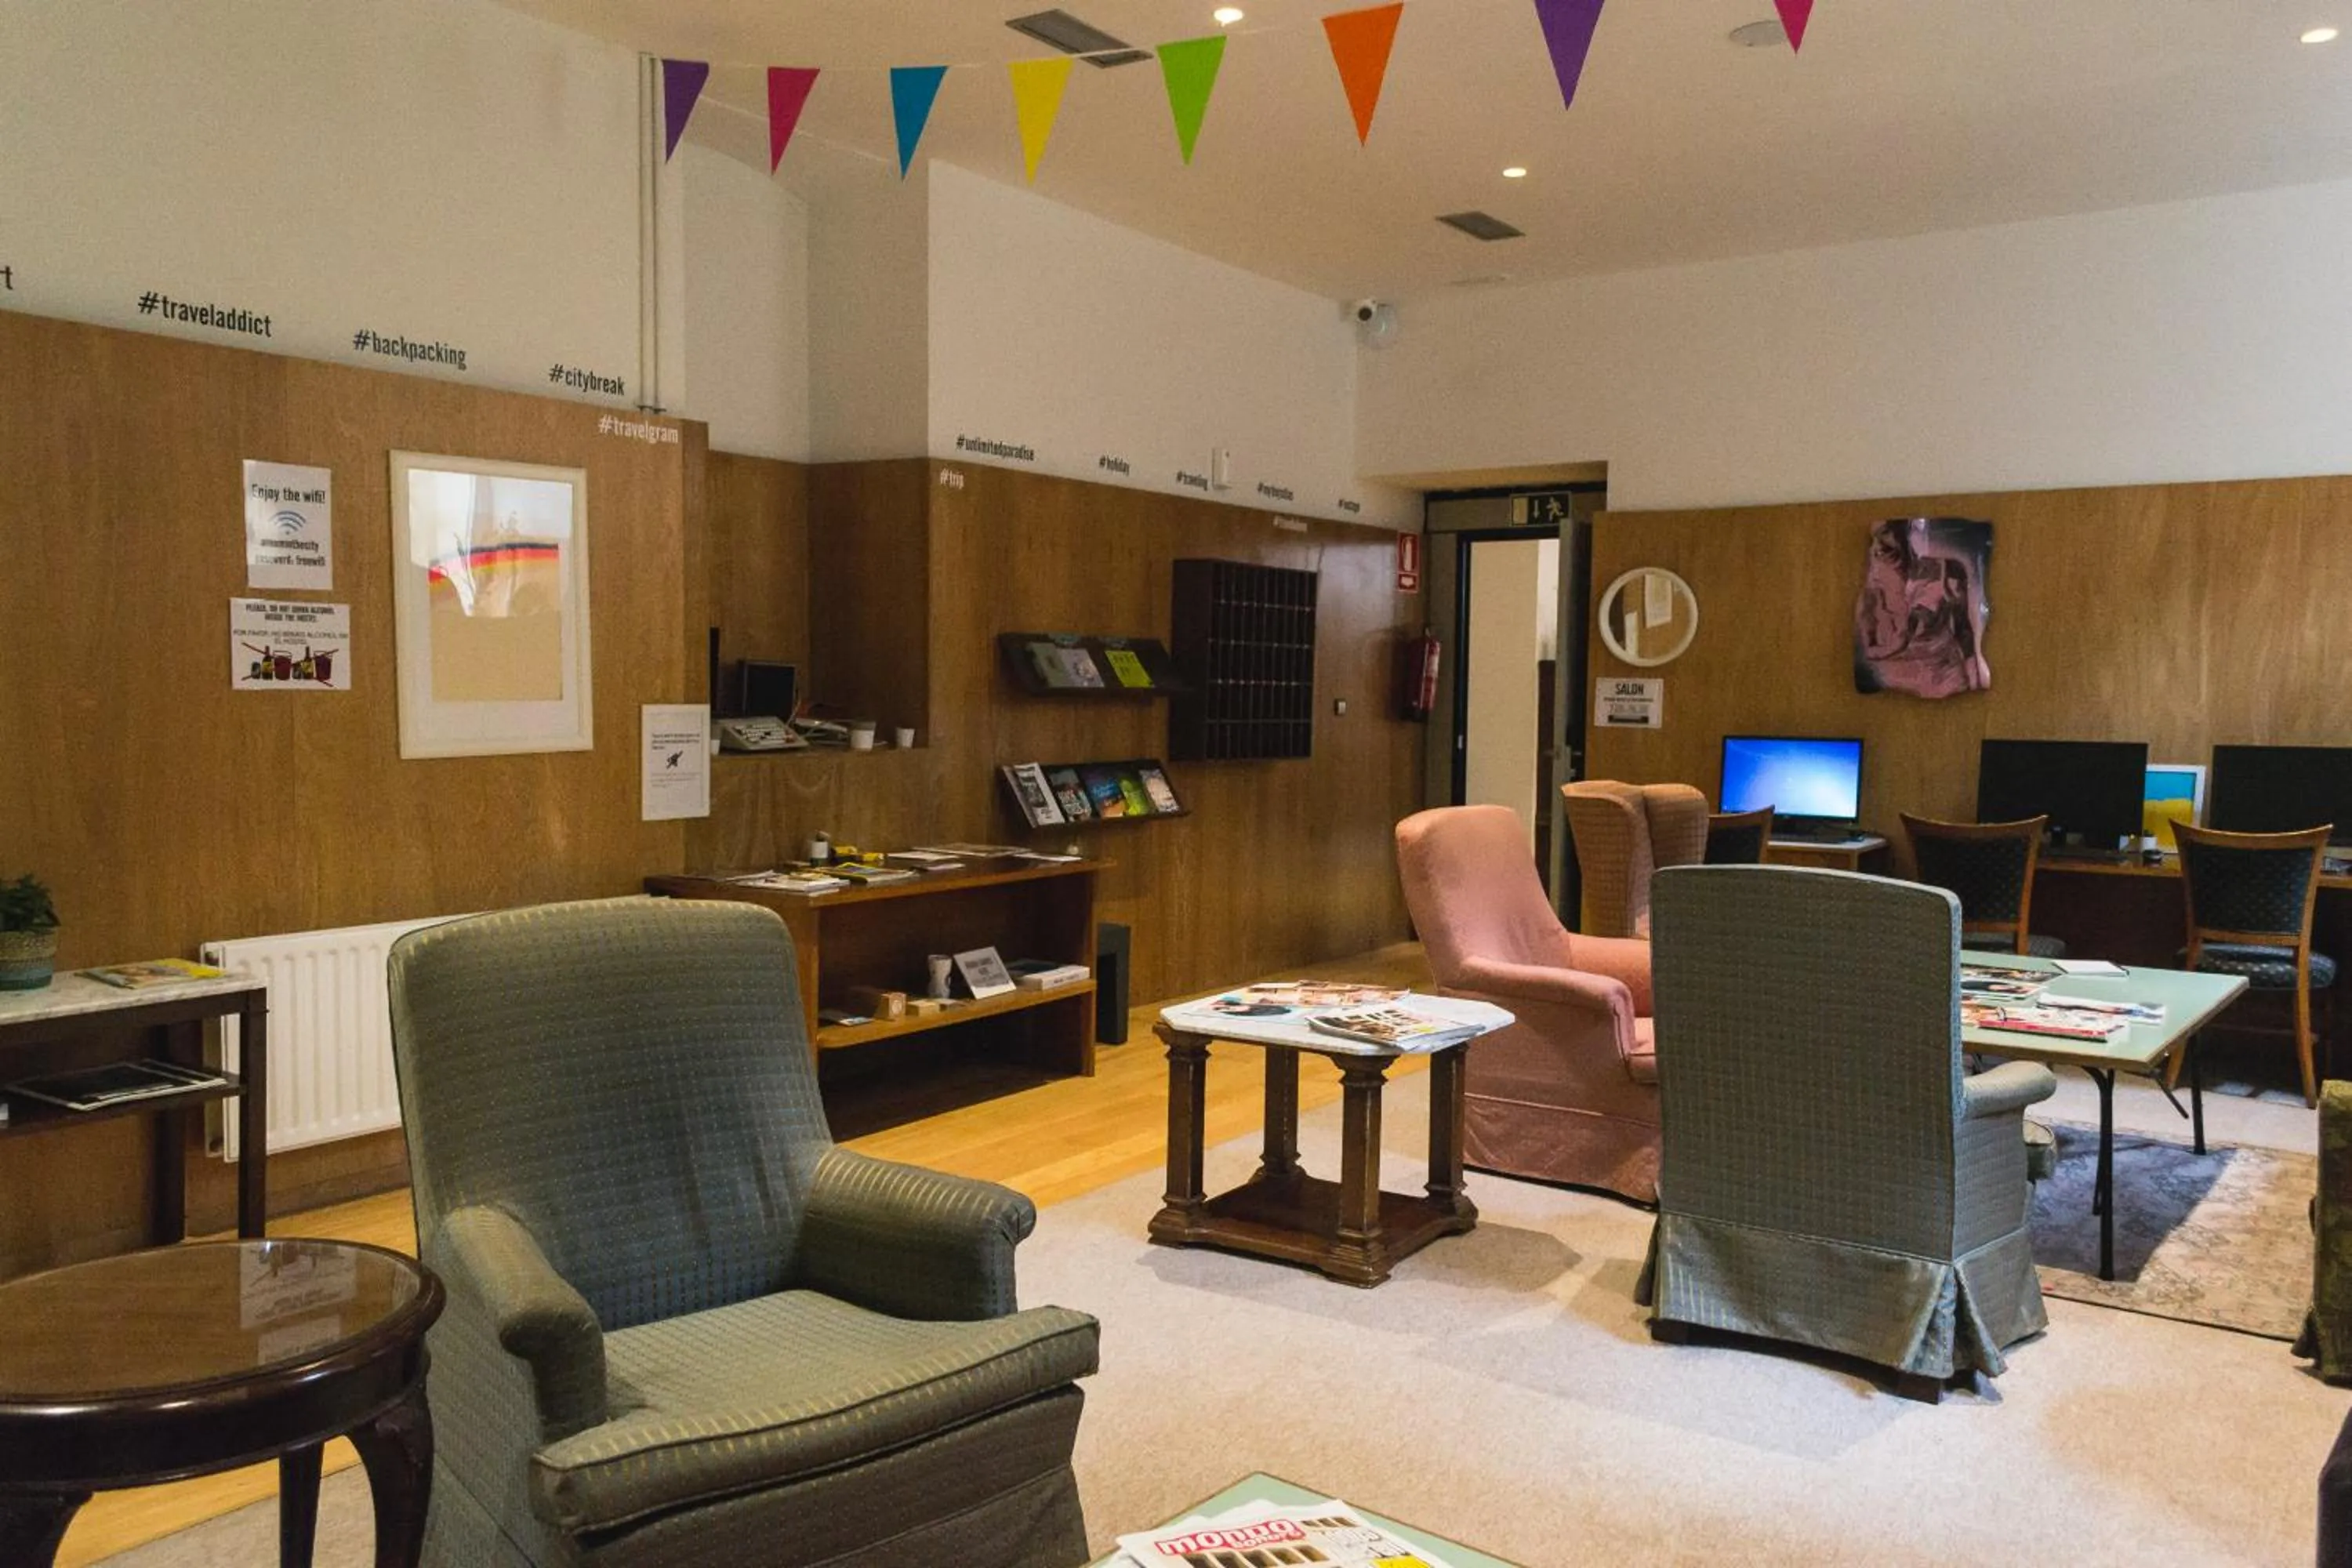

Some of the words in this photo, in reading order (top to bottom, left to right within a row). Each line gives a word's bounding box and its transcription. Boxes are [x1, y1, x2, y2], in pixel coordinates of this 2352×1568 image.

[137, 291, 272, 337] #traveladdict
[353, 329, 466, 370] #backpacking
[550, 364, 625, 395] #citybreak
[598, 414, 679, 444] #travelgram
[252, 484, 280, 503] Enjoy
[283, 487, 300, 501] the
[303, 490, 325, 503] wifi!
